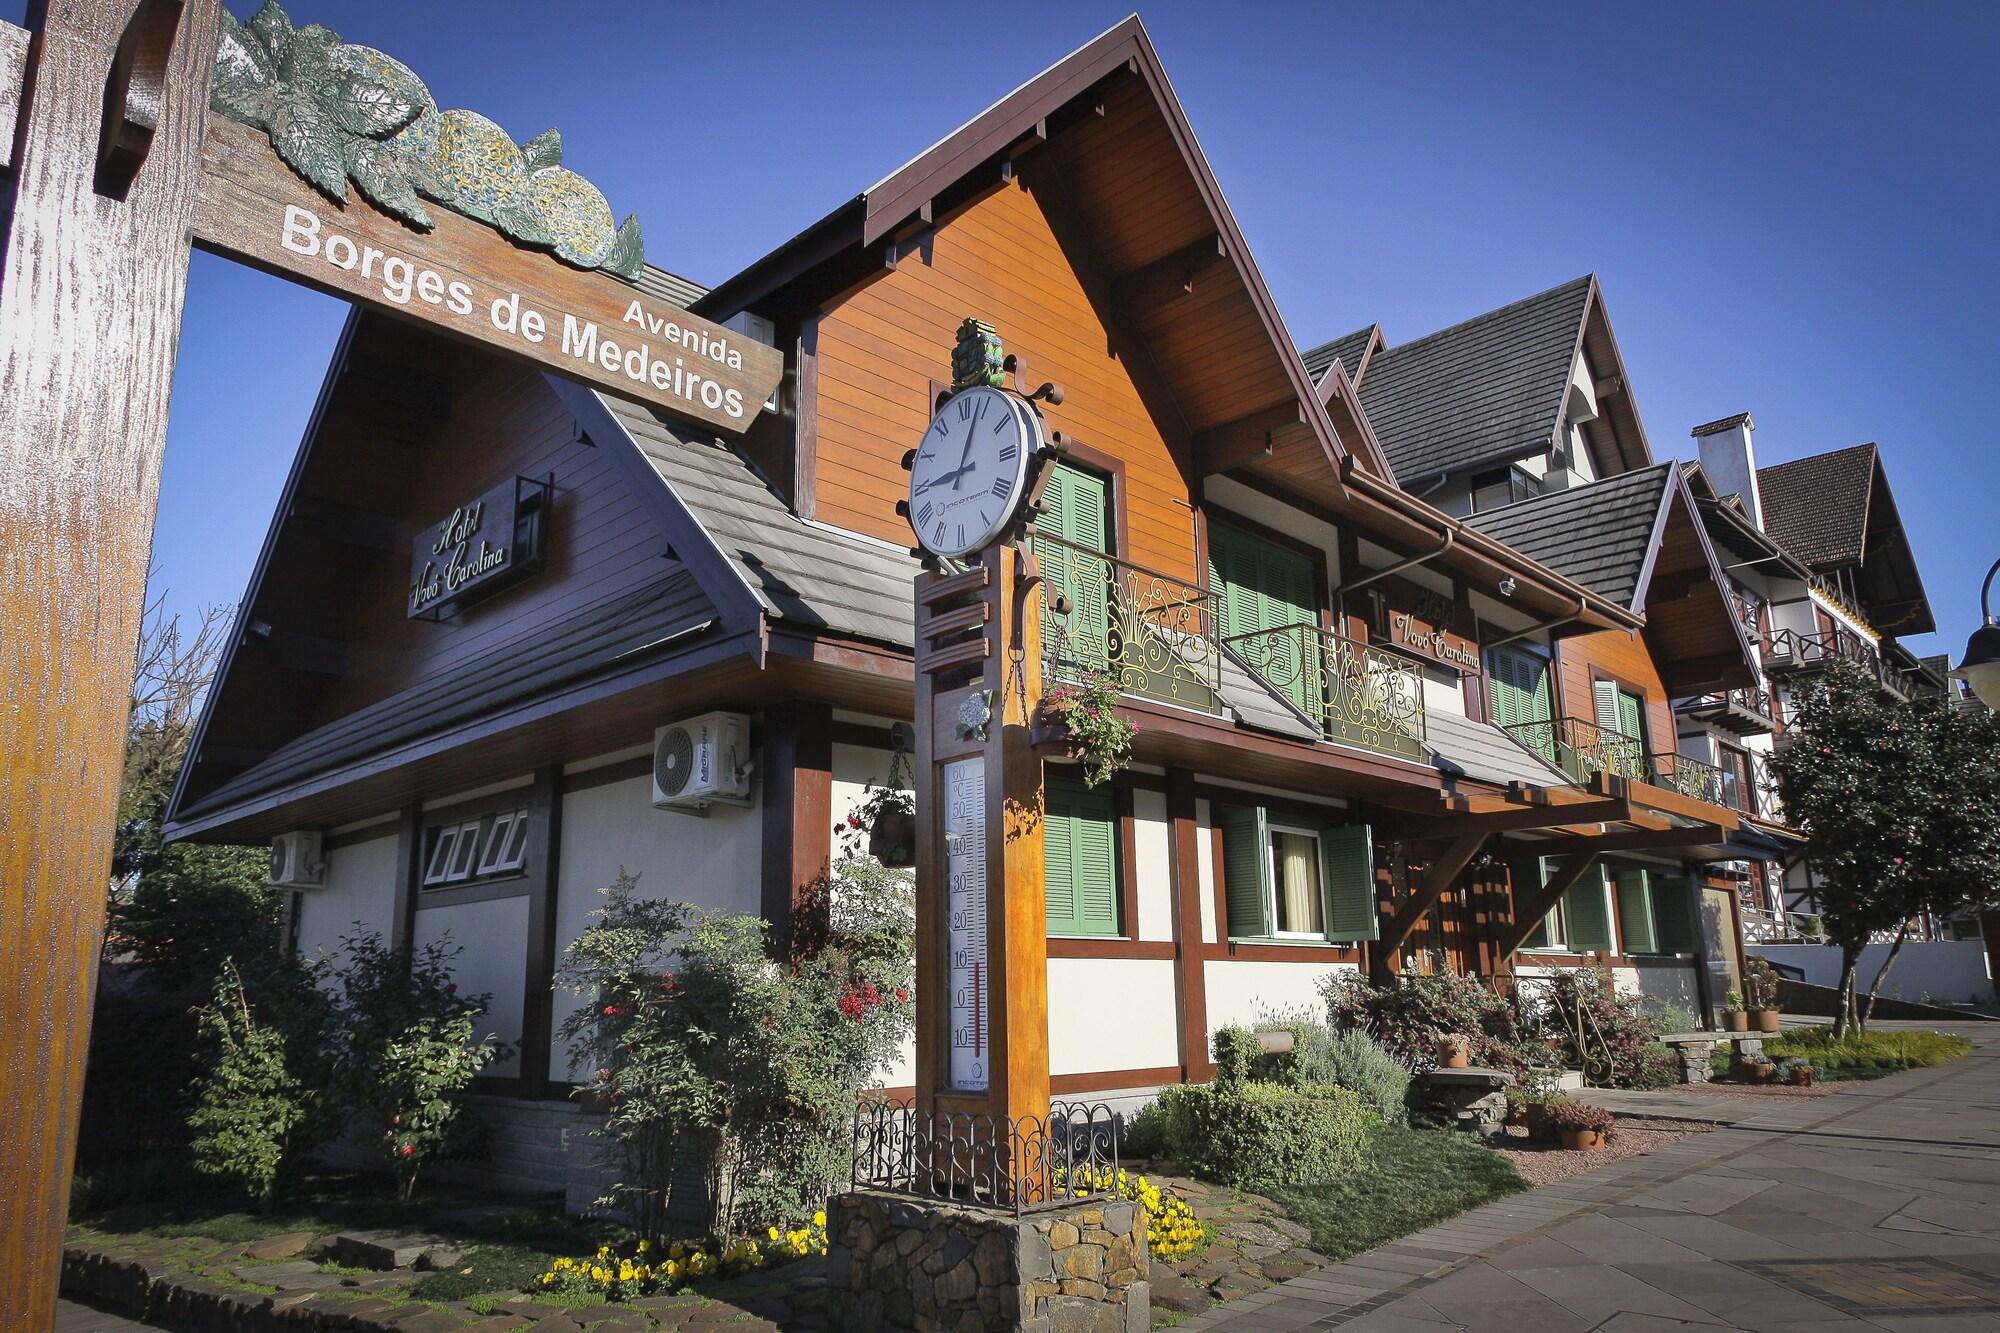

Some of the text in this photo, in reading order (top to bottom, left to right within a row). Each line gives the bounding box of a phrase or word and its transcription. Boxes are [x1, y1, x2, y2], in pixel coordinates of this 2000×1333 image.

[281, 204, 745, 418] Borges de Medeiros
[622, 299, 743, 371] Avenida
[433, 502, 481, 555] Hotel
[444, 541, 504, 591] Carolina
[1396, 613, 1480, 669] Vovó Carolina
[952, 801, 966, 817] 50
[952, 837, 966, 854] 40
[953, 873, 967, 891] 30
[954, 912, 967, 929] 20
[955, 950, 968, 967] 10
[957, 989, 965, 1007] 0
